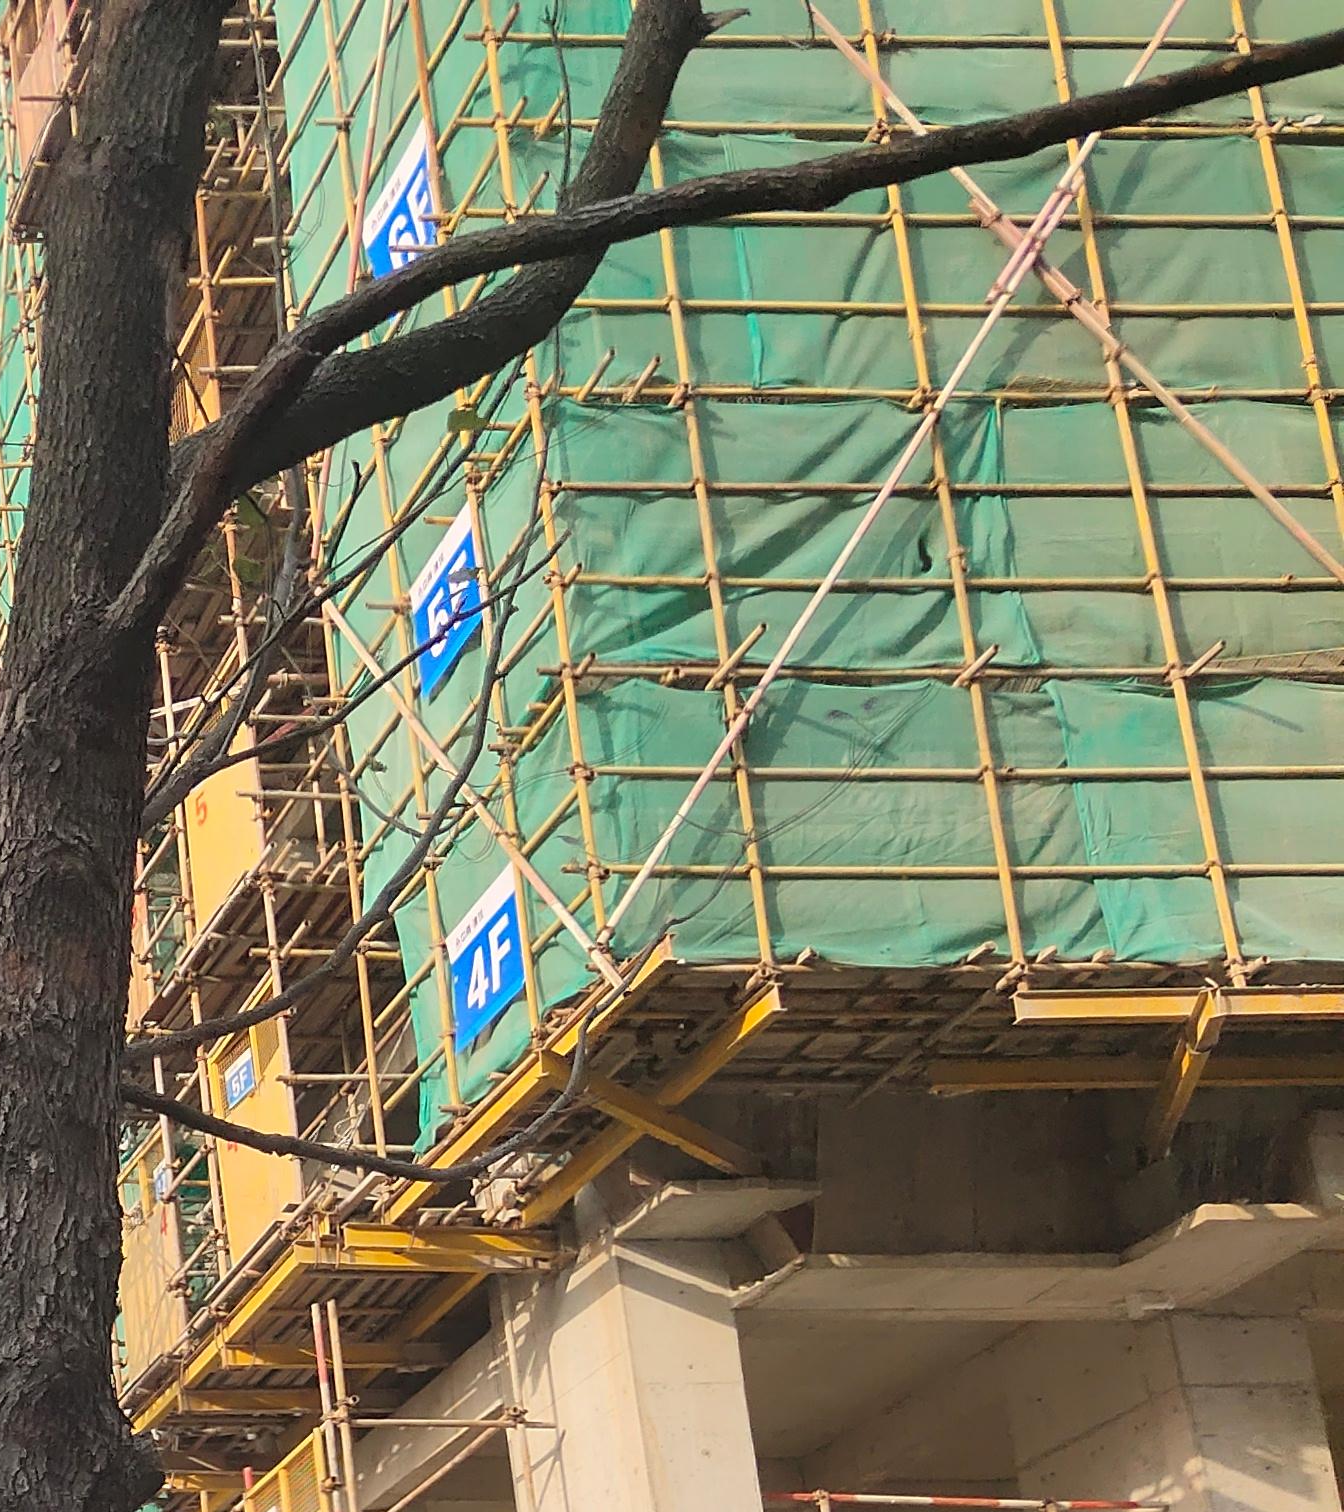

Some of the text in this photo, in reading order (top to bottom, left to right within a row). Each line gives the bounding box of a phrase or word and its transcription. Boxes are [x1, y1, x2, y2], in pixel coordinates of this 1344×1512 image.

[427, 550, 469, 657] 5F
[195, 792, 207, 826] 5
[467, 912, 511, 1010] 4F
